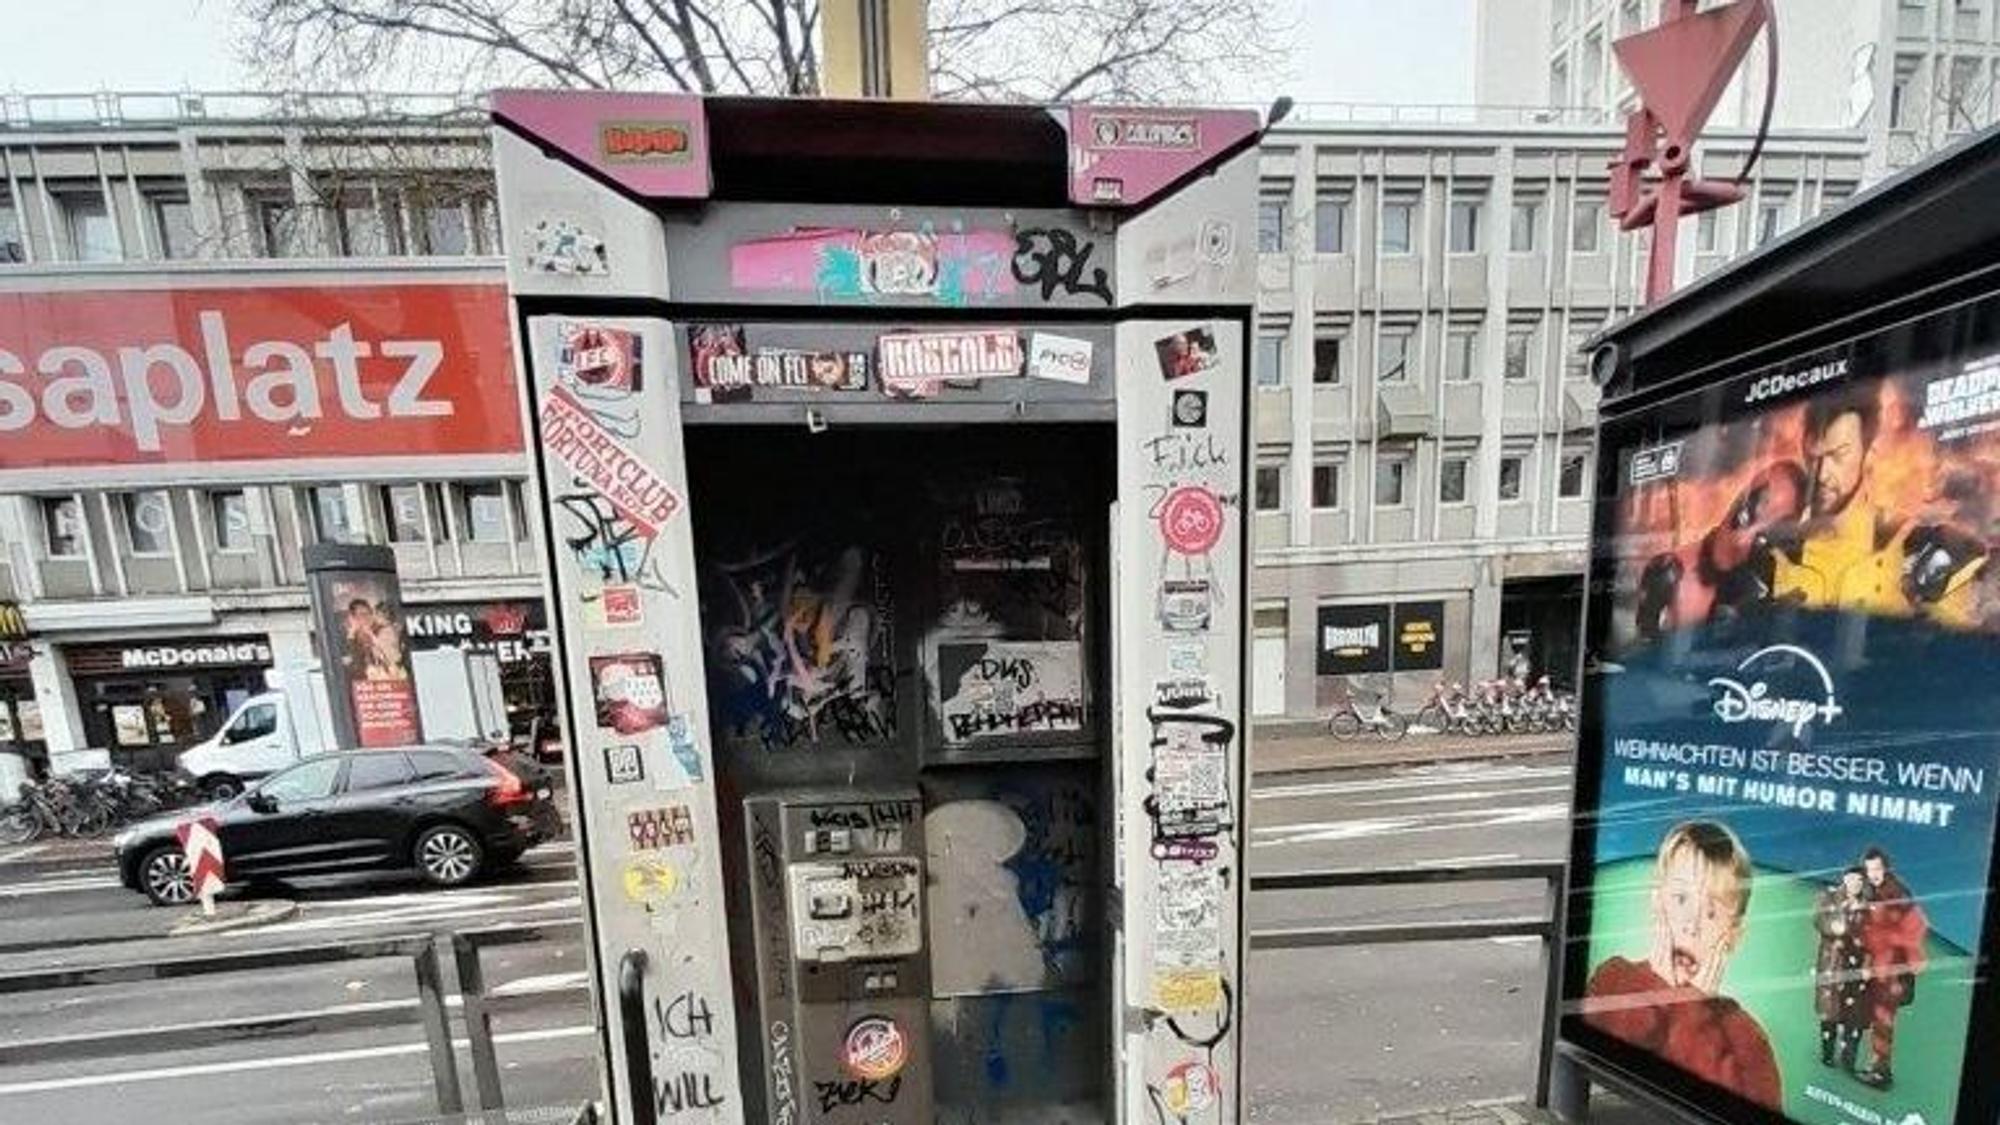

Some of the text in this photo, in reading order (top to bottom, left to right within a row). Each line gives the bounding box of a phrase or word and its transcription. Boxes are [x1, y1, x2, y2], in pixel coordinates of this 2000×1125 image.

[709, 355, 752, 385] COME
[757, 355, 780, 384] ON
[884, 331, 1016, 378] RASCALS
[1744, 359, 1849, 402] JCDecaux
[542, 404, 613, 490] FORTUNA
[406, 613, 474, 637] KING
[122, 642, 271, 668] McDonald's
[1708, 668, 1843, 738] Disney+
[1615, 736, 1746, 769] WEIHNACHTEN
[1750, 749, 1781, 772] IST
[1898, 761, 1984, 794] WENN
[1624, 766, 1955, 827] MAN'S MIT HUMOR NIMMT
[653, 992, 714, 1042] ICH
[652, 1070, 725, 1116] WILL
